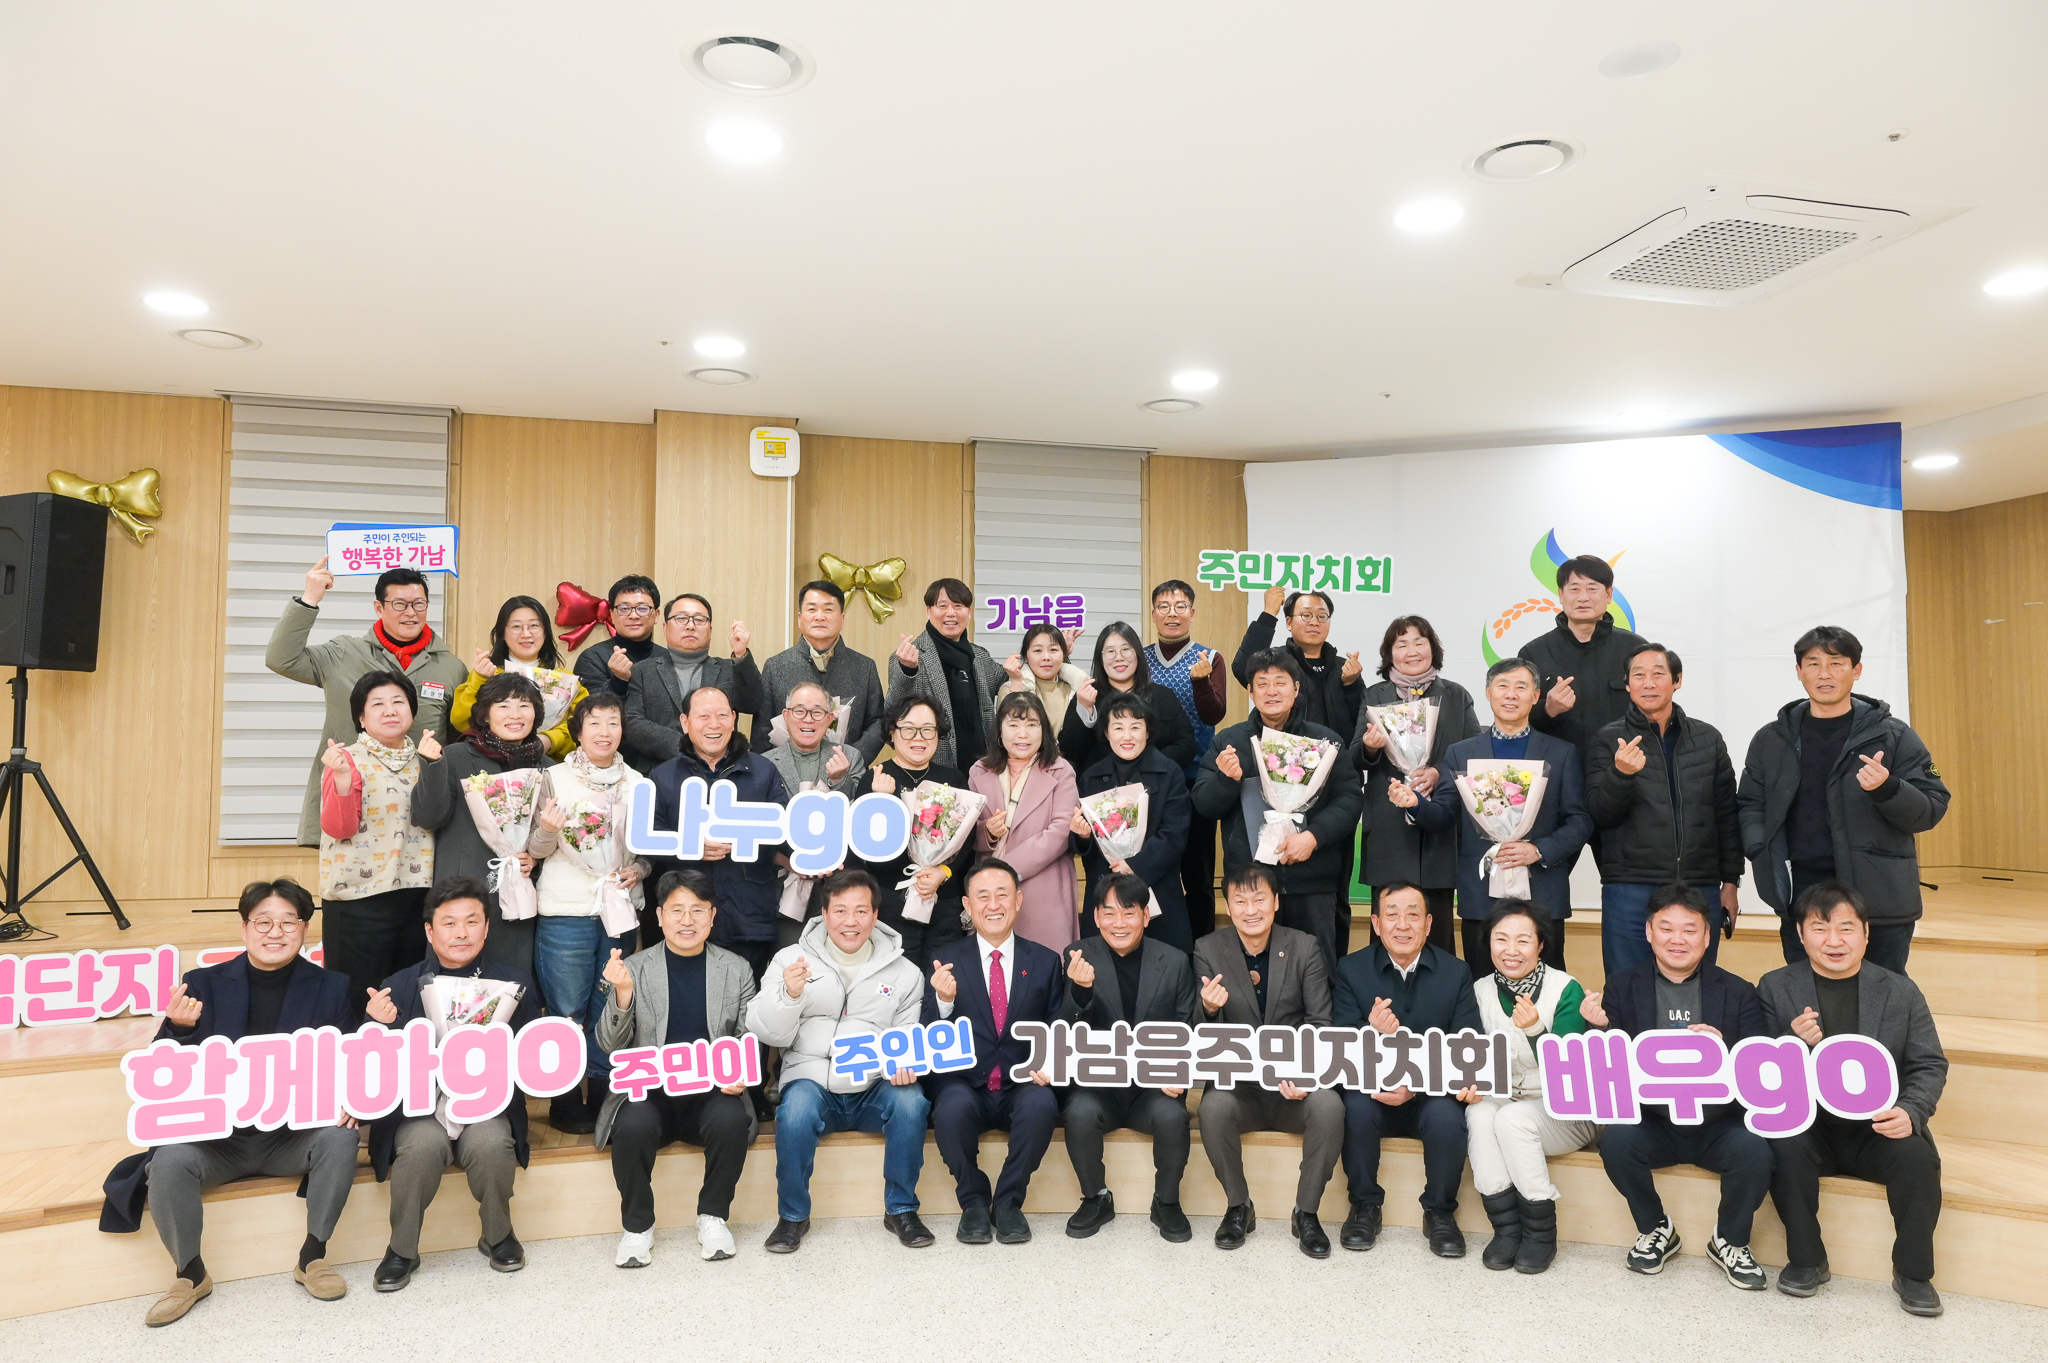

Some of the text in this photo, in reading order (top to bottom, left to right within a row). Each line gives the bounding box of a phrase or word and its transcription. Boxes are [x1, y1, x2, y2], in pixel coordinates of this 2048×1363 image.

[342, 545, 446, 571] 행복한 가남
[363, 532, 427, 544] 주민이 주인되는
[1199, 553, 1392, 594] 주민자치회
[987, 595, 1085, 630] 가남읍
[630, 781, 906, 870] 나누go
[613, 1036, 758, 1098] 주민이
[834, 1020, 973, 1081] 주인인
[1010, 1023, 1510, 1095] 가남읍주민자치회
[128, 1022, 582, 1141] 함께하go
[1543, 1035, 1892, 1132] 배우go
